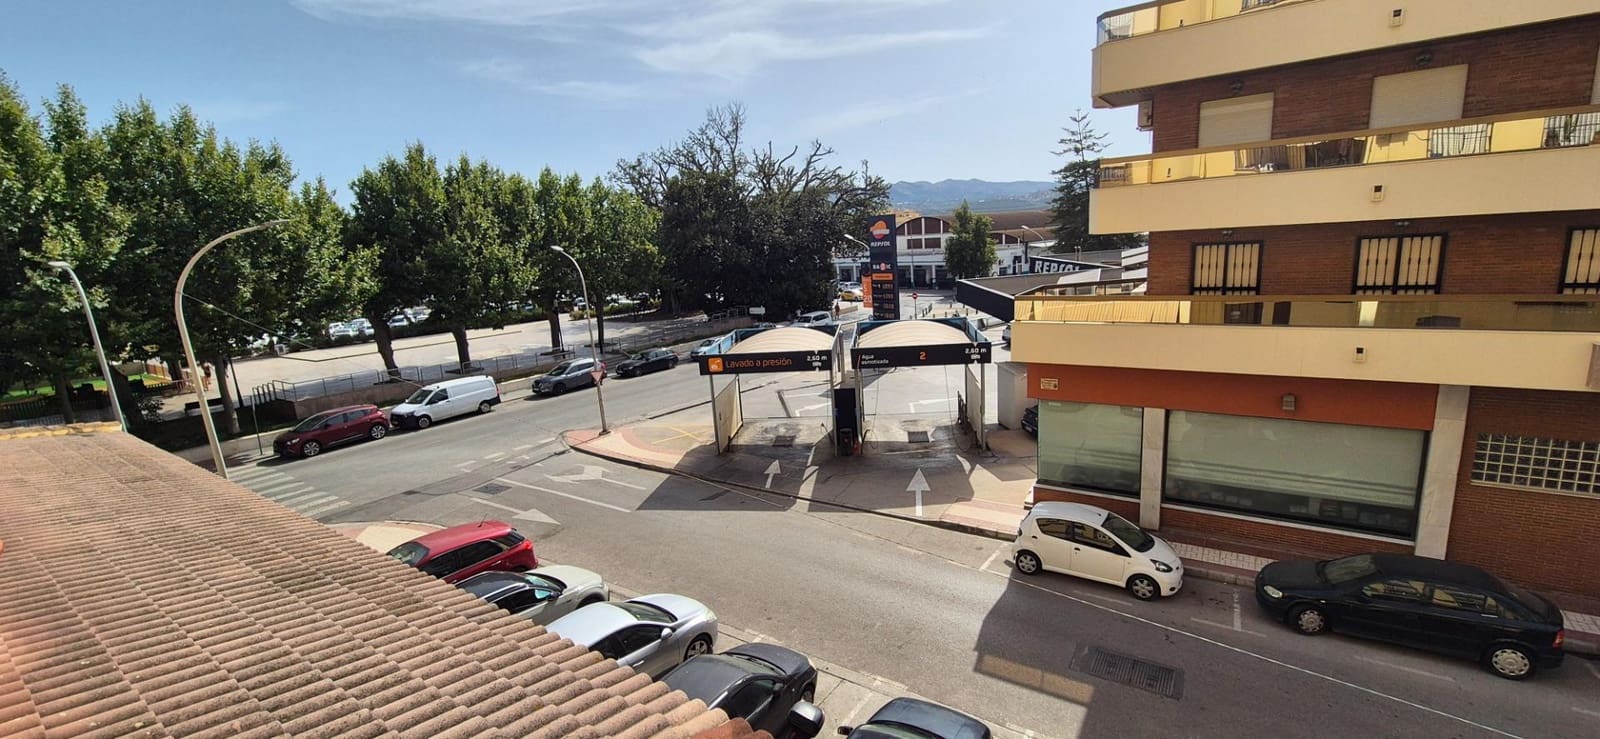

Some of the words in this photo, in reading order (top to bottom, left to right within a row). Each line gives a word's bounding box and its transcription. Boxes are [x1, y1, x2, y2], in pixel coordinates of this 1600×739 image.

[919, 351, 927, 360] 2
[726, 359, 754, 368] Lavado
[763, 357, 792, 368] presión
